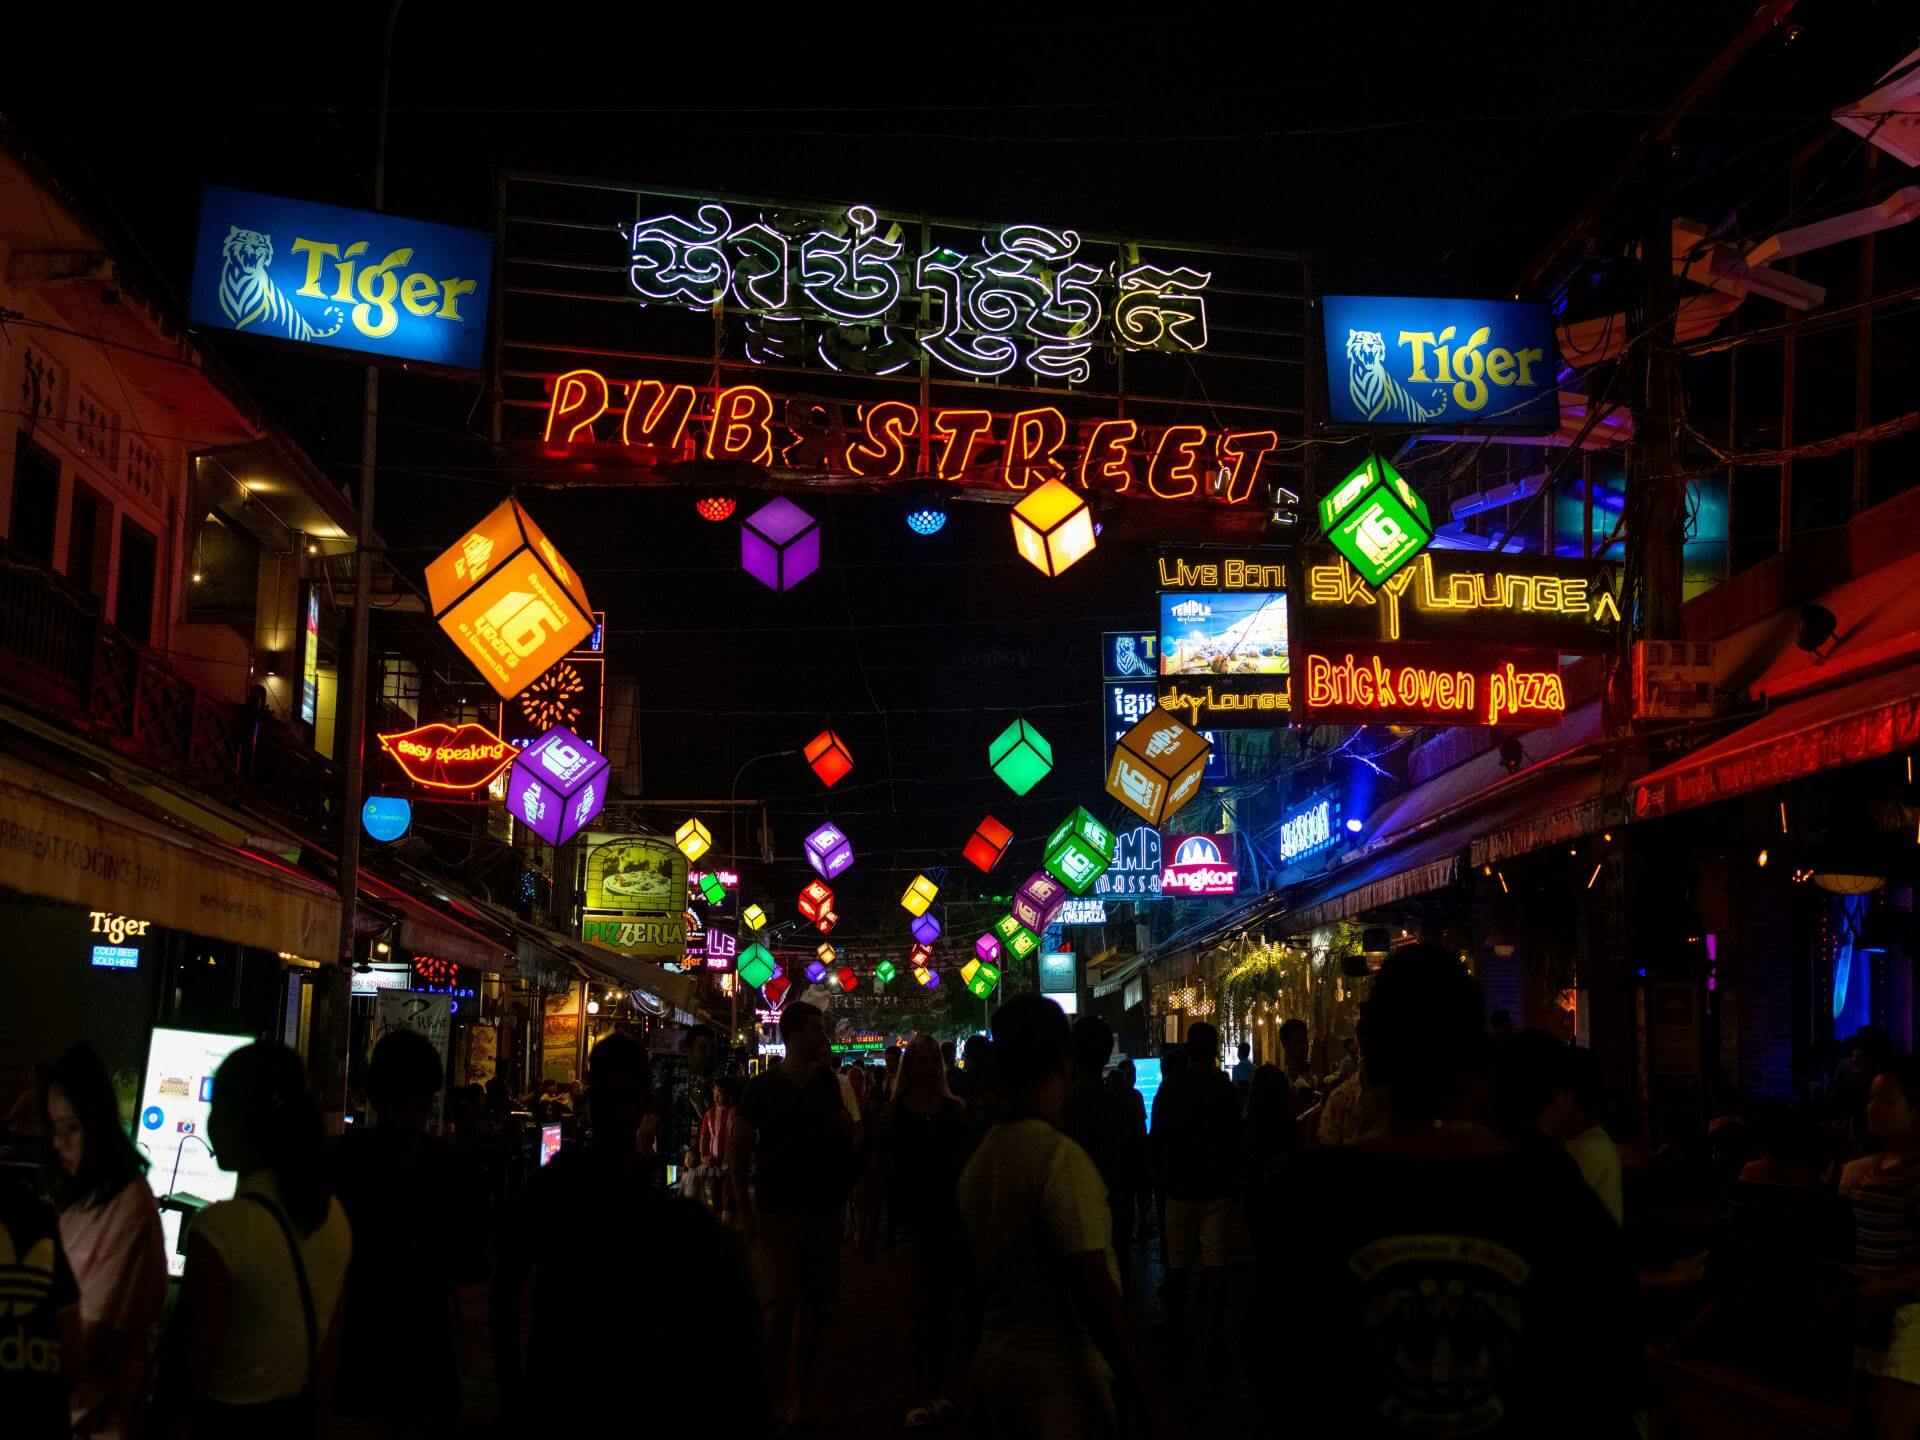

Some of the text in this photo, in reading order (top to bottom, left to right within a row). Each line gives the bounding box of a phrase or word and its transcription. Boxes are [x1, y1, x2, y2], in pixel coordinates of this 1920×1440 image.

[291, 238, 475, 339] Tiger
[1397, 326, 1543, 411] Tiger
[545, 369, 773, 467] PUB
[846, 401, 1278, 504] STREET
[1158, 557, 1218, 587] Live
[473, 615, 521, 669] years
[483, 591, 565, 658] 16
[1307, 653, 1565, 726] Brick oven pizza
[397, 740, 433, 762] easy
[435, 743, 504, 764] speaking
[541, 738, 581, 777] 16
[1162, 867, 1239, 892] Angkor
[89, 911, 151, 945] Tiger
[584, 920, 685, 948] PIZZERIA
[366, 978, 406, 989] speaking
